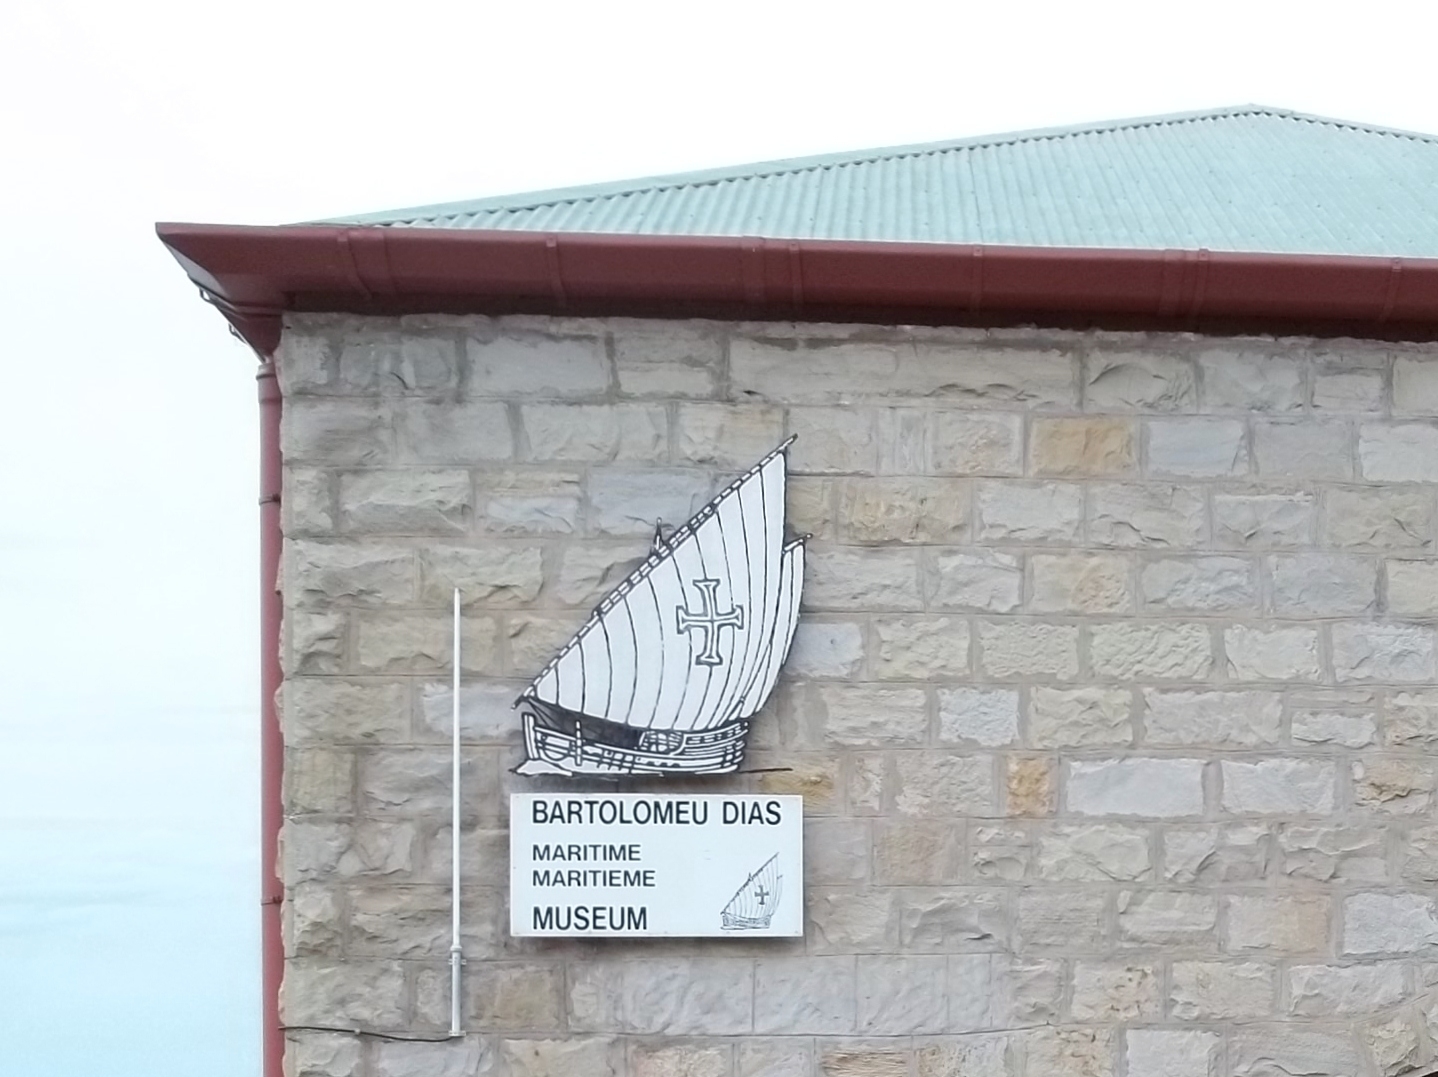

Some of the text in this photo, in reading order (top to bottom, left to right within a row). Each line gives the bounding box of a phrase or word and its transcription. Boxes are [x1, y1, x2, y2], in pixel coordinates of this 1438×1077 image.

[532, 800, 782, 825] BARTOLOMEU DIAS
[532, 844, 641, 861] MARITIME
[532, 870, 656, 887] MARITIEME
[533, 906, 647, 930] MUSEUM
